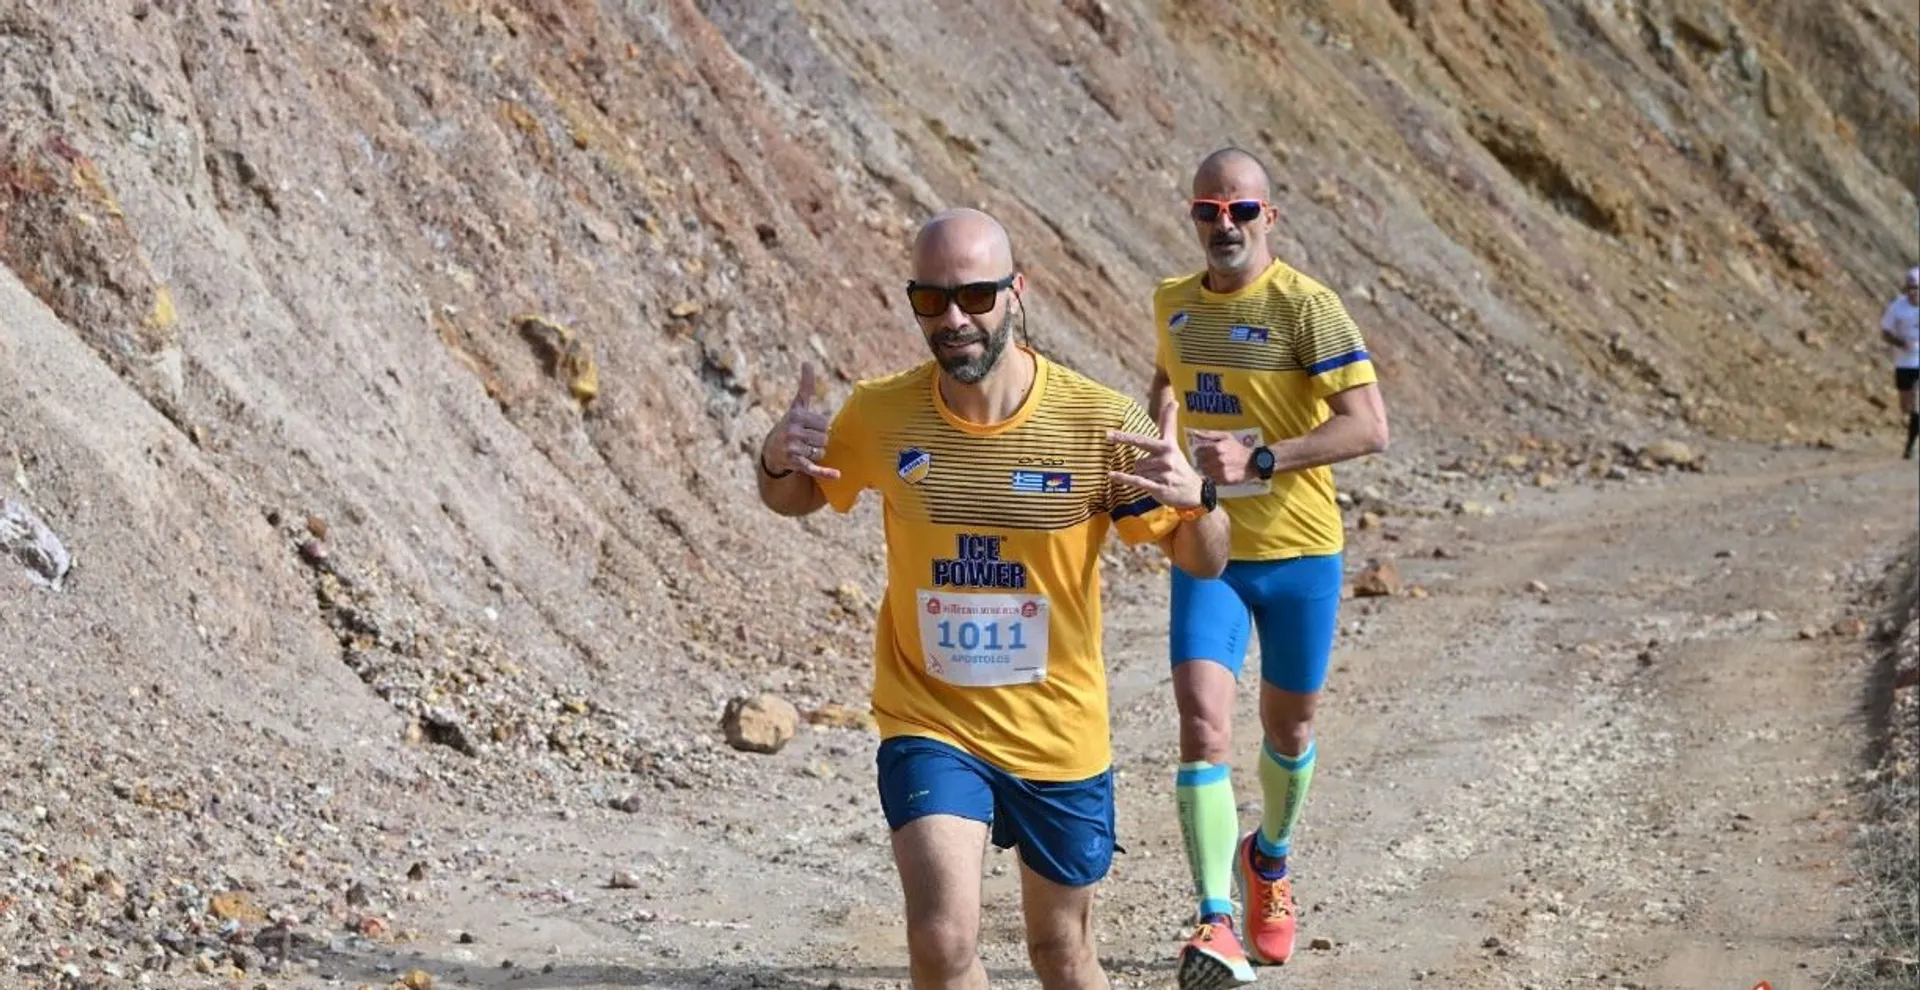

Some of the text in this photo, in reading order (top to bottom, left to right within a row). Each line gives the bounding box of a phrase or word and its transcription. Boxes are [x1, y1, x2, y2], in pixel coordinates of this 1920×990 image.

[1196, 373, 1223, 393] ICE
[956, 533, 1001, 561] ICE
[932, 558, 1027, 589] POWER
[937, 620, 1027, 650] 1011
[951, 654, 1011, 664] APOSTOLOS
